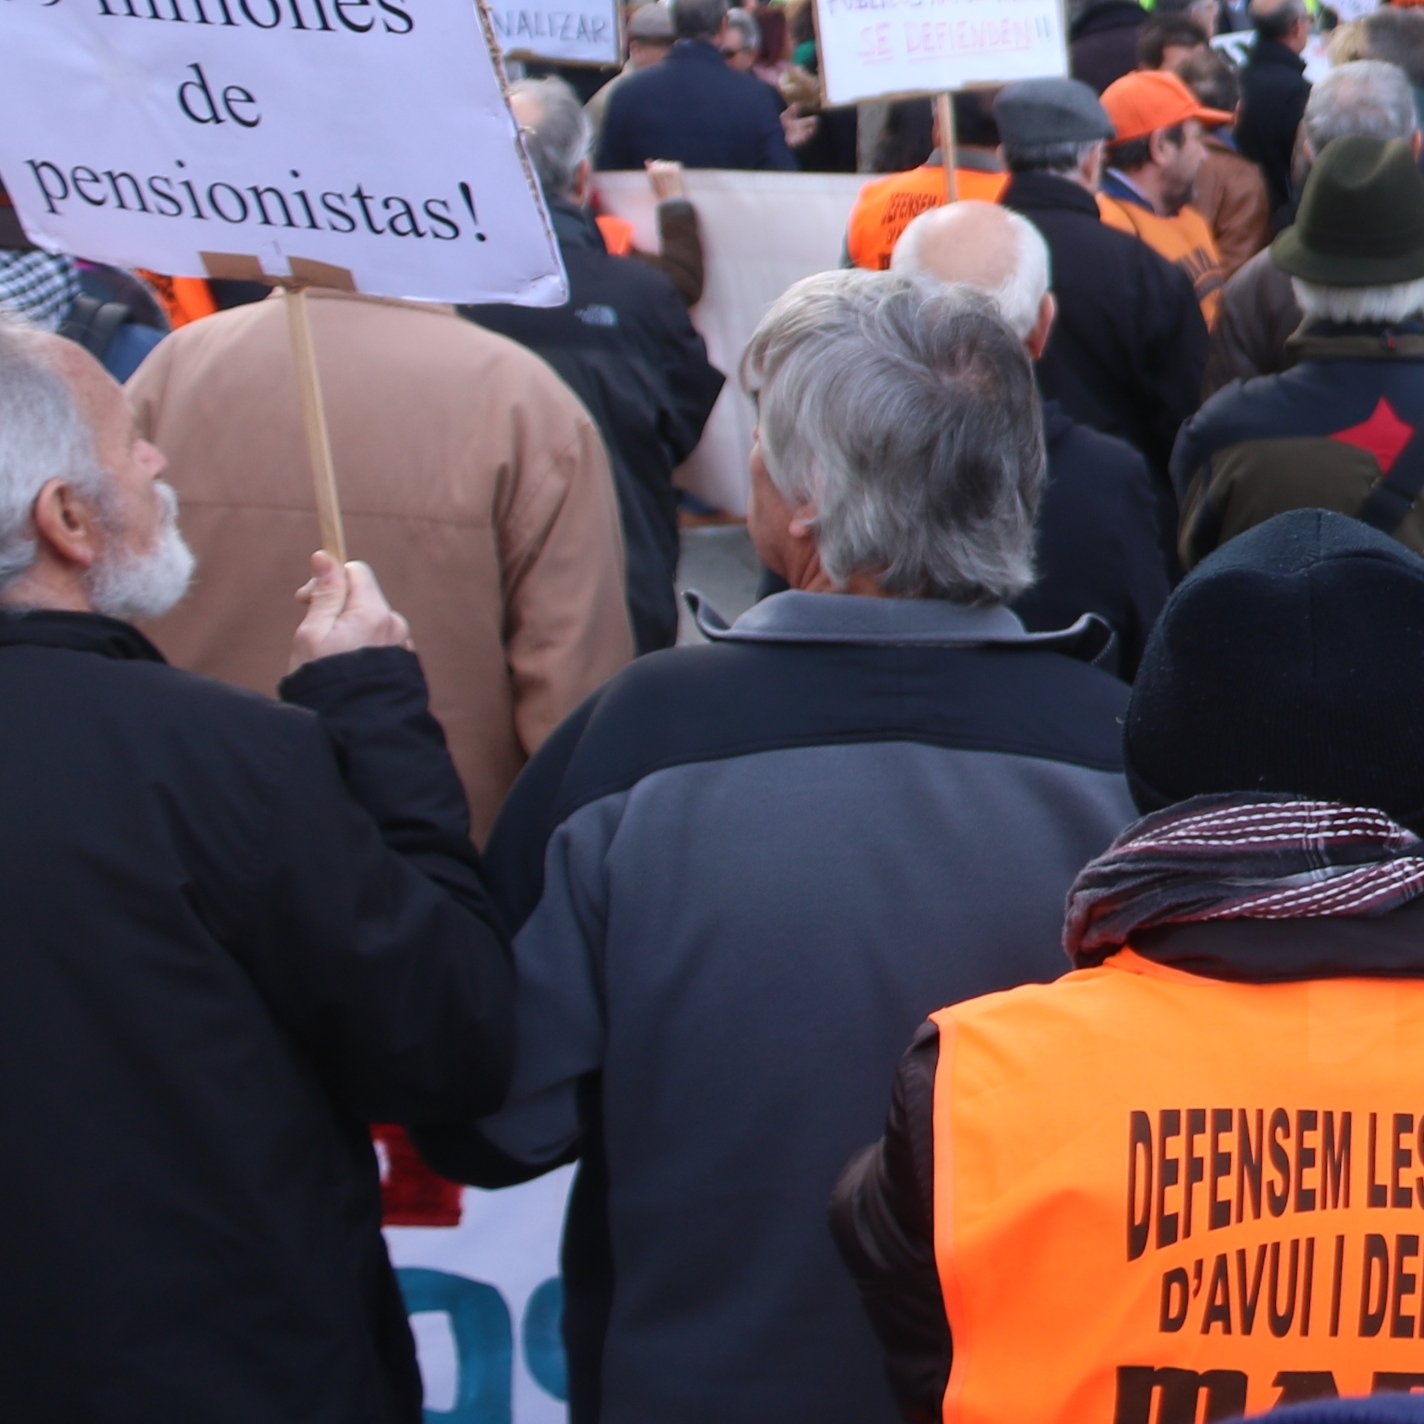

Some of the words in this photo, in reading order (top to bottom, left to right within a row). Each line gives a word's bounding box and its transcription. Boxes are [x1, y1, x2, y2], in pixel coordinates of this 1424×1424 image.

[858, 21, 893, 57] SE
[177, 62, 261, 129] de
[24, 158, 488, 243] pensionistas!
[1126, 1107, 1353, 1263] DEFENSEM
[1158, 1236, 1316, 1338] D'AVUI
